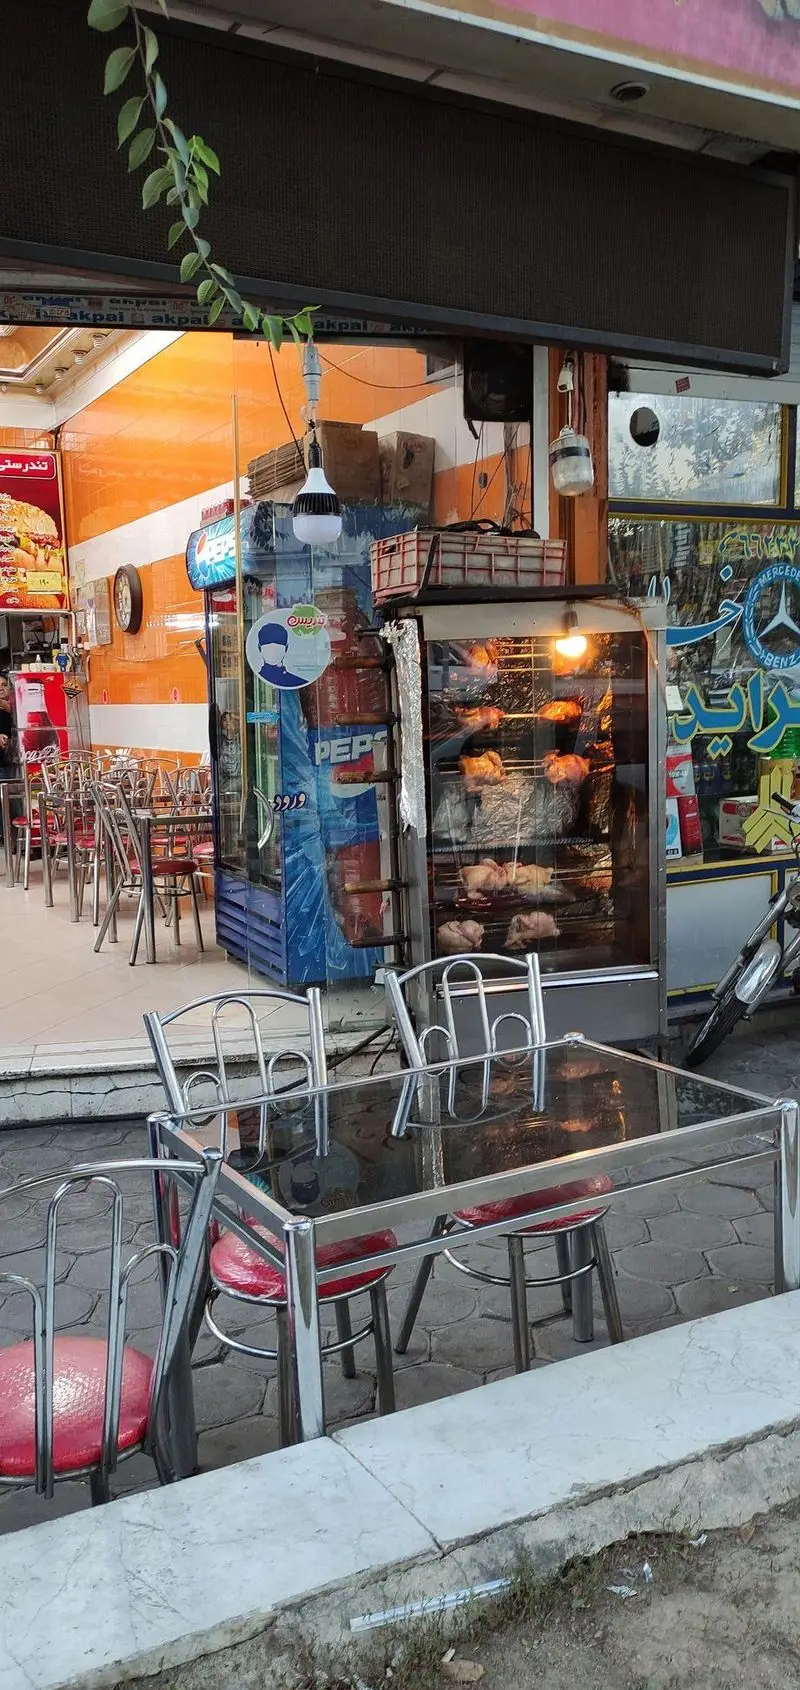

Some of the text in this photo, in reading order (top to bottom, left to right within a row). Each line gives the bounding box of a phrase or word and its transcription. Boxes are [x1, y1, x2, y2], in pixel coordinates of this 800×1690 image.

[67, 309, 125, 323] akpai
[151, 311, 208, 327] akpai
[314, 319, 367, 332] akpai
[763, 651, 797, 669] BENZ
[669, 668, 800, 761] راید
[273, 793, 307, 812] ورود
